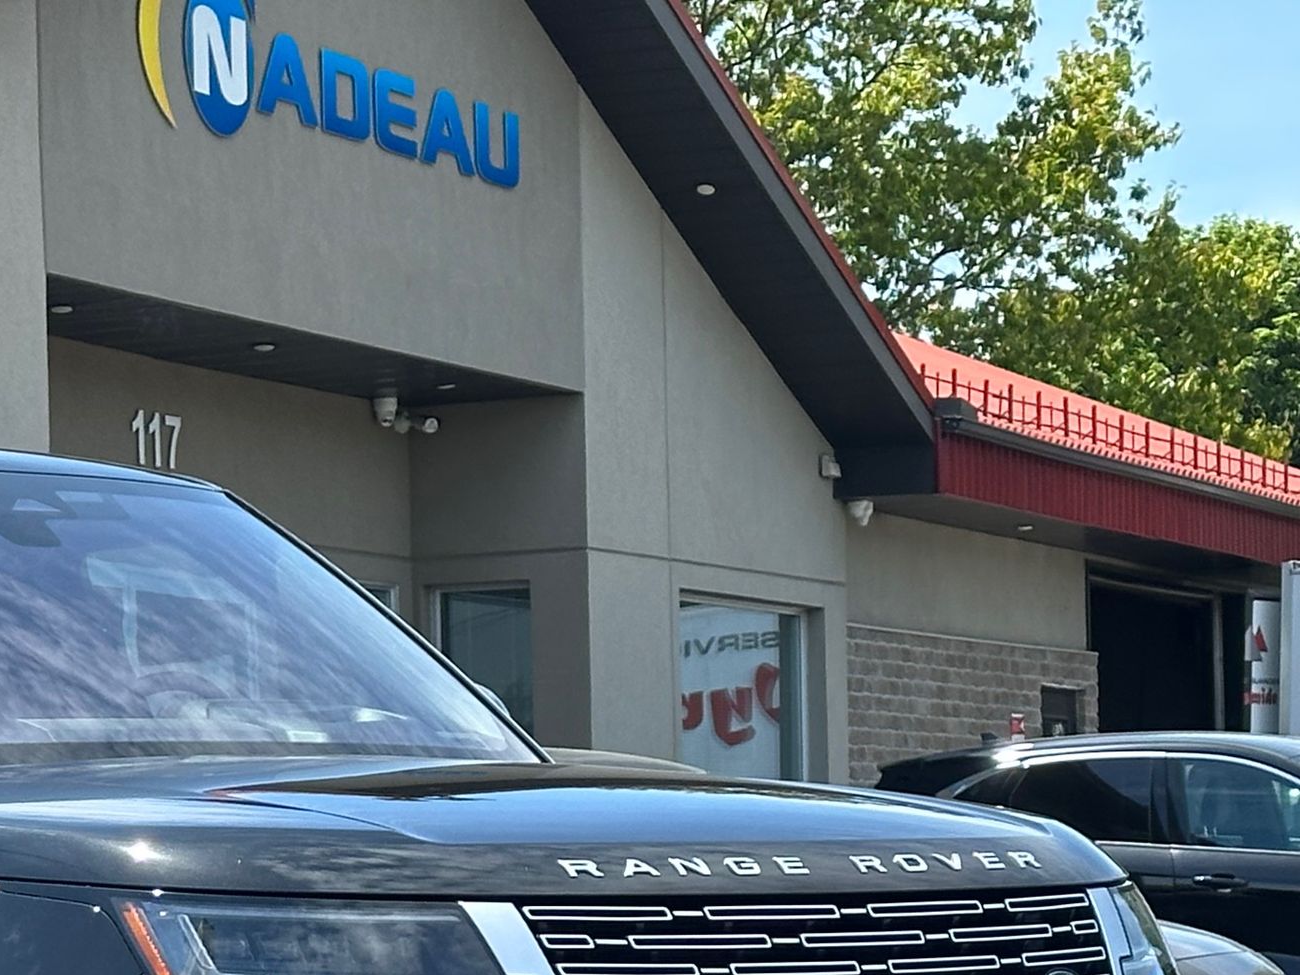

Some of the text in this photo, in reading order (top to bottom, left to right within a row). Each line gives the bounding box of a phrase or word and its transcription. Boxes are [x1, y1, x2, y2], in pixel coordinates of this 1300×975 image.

[192, 4, 520, 189] NADEAU
[132, 409, 182, 469] 117
[557, 851, 1042, 878] RANGE ROVER
